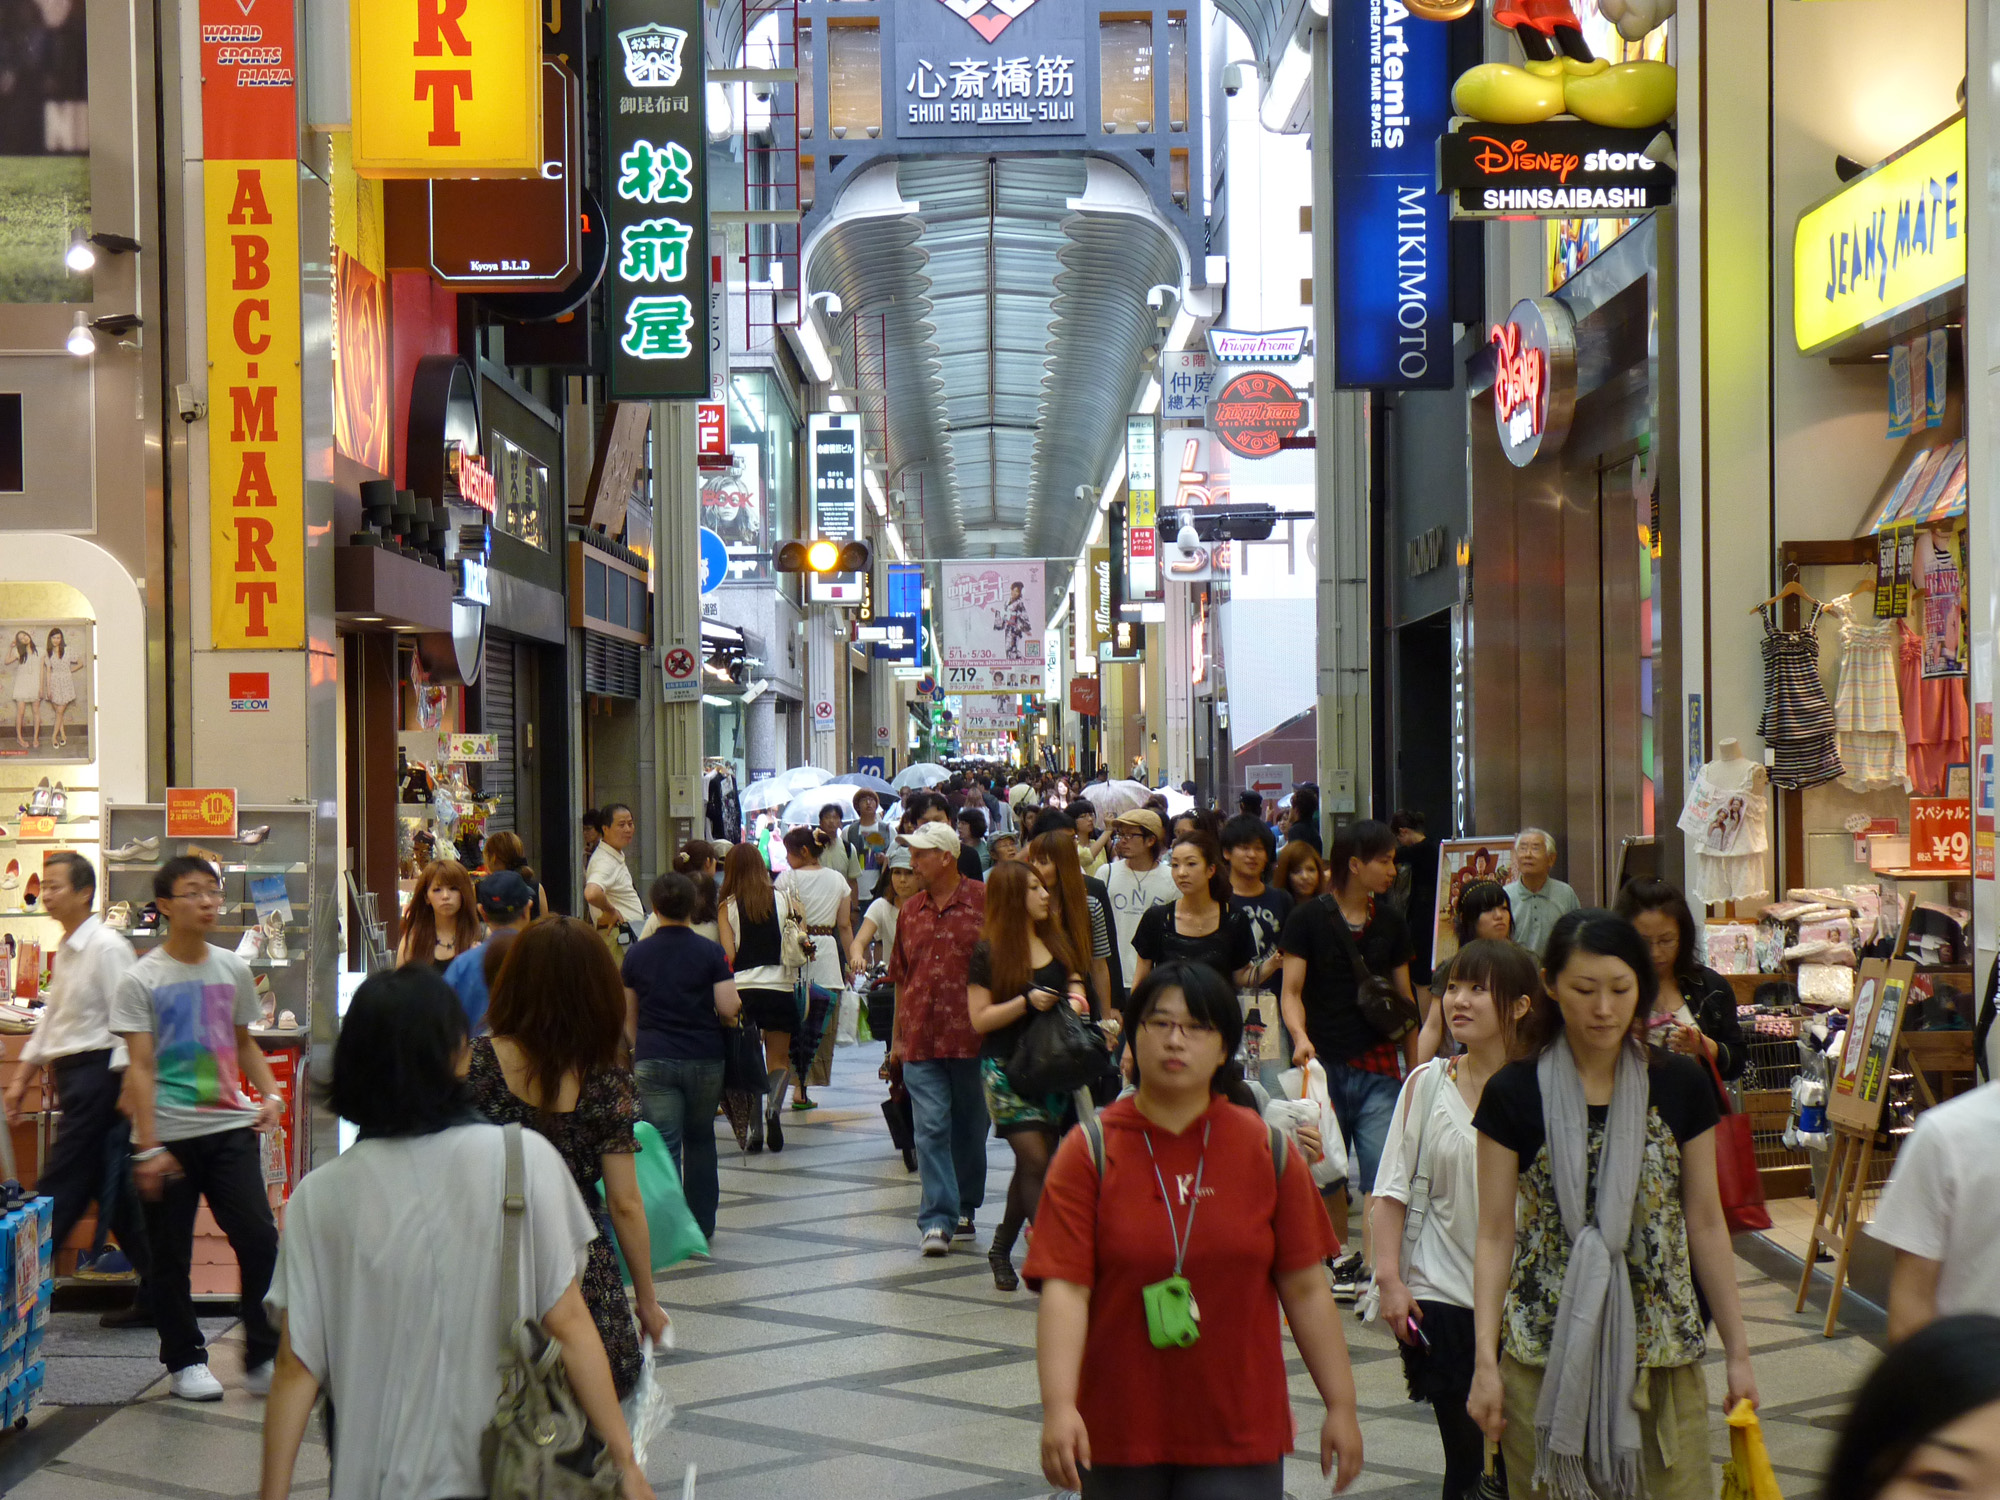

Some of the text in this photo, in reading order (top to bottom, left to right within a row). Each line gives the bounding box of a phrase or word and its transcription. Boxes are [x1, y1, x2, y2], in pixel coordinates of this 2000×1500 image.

[203, 25, 262, 42] WORLD
[217, 47, 281, 65] SPORTS
[237, 69, 293, 87] PLAZA
[906, 54, 1075, 99] 心斎橋筋
[1371, 67, 1381, 101] HAIR
[1384, 0, 1410, 149] Artemis
[619, 95, 689, 114] 御昆布司
[908, 103, 944, 123] SHIN
[950, 103, 976, 123] SAI
[1371, 104, 1381, 148] SPACE
[1583, 149, 1656, 171] store
[1483, 188, 1646, 209] SHINSAIBASHI
[1825, 170, 1958, 303] JEANS MATE
[617, 139, 694, 360] 松前屋
[470, 261, 498, 272] Kyoya
[1397, 184, 1428, 379] MIKIMOTO
[1219, 338, 1297, 354] Krispy Kreme
[1237, 378, 1276, 396] HOT
[1168, 394, 1209, 410] 總本
[1215, 402, 1302, 422] Krispy Kreme
[1236, 430, 1280, 449] NOW
[459, 439, 496, 514] Question
[702, 490, 754, 508] BOOK
[231, 700, 268, 709] SECOM
[461, 740, 493, 755] SAL
[1455, 637, 1464, 838] MIKIMO
